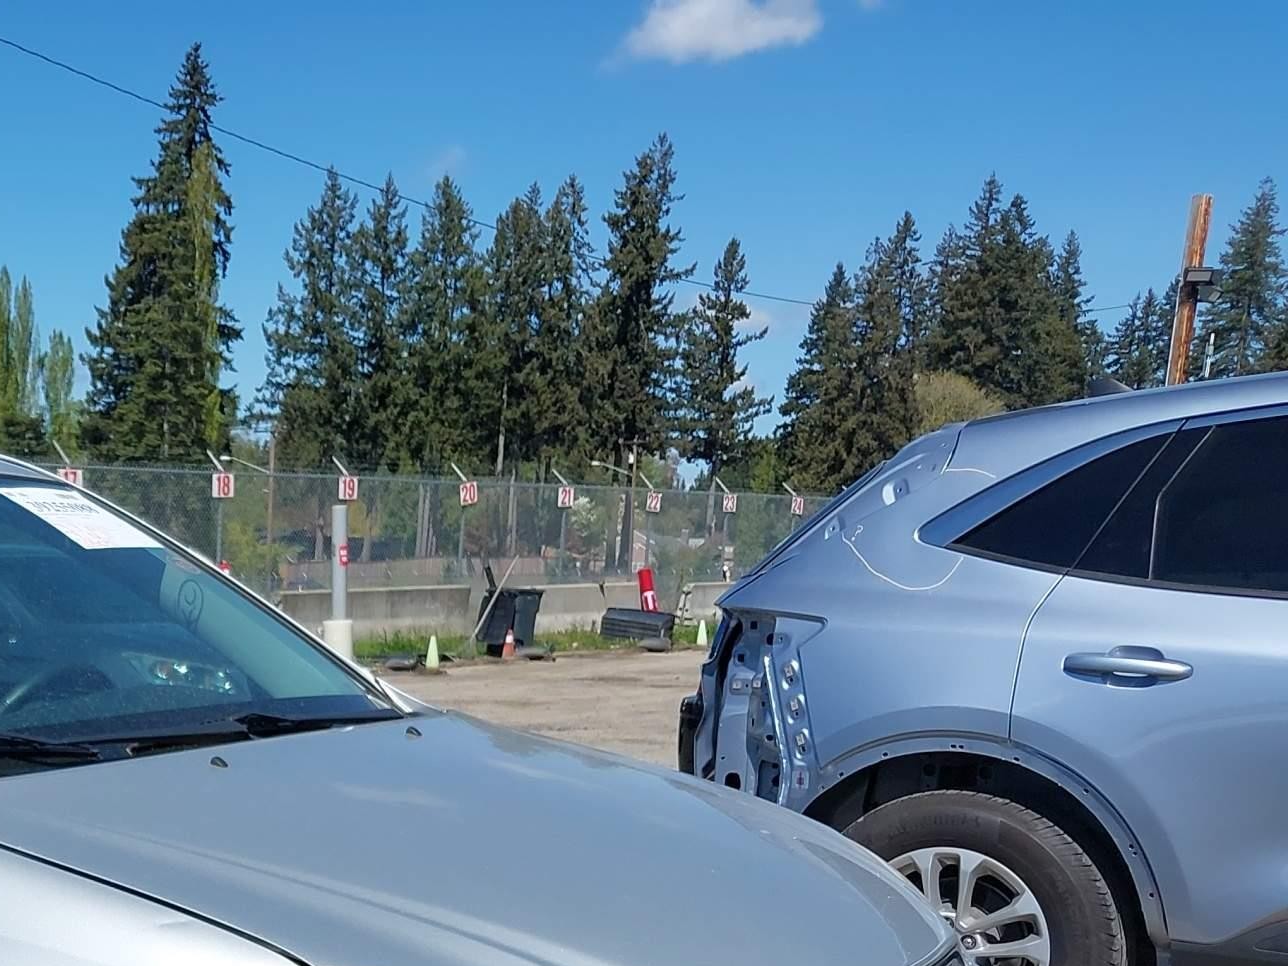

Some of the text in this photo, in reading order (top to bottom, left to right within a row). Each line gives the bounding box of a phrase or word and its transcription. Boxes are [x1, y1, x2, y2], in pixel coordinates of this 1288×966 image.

[217, 475, 230, 496] 18
[342, 478, 355, 497] 19
[462, 484, 476, 502] 20
[561, 488, 571, 505] 21
[648, 494, 659, 510] 22
[724, 495, 735, 511] 23
[792, 498, 802, 513] 24
